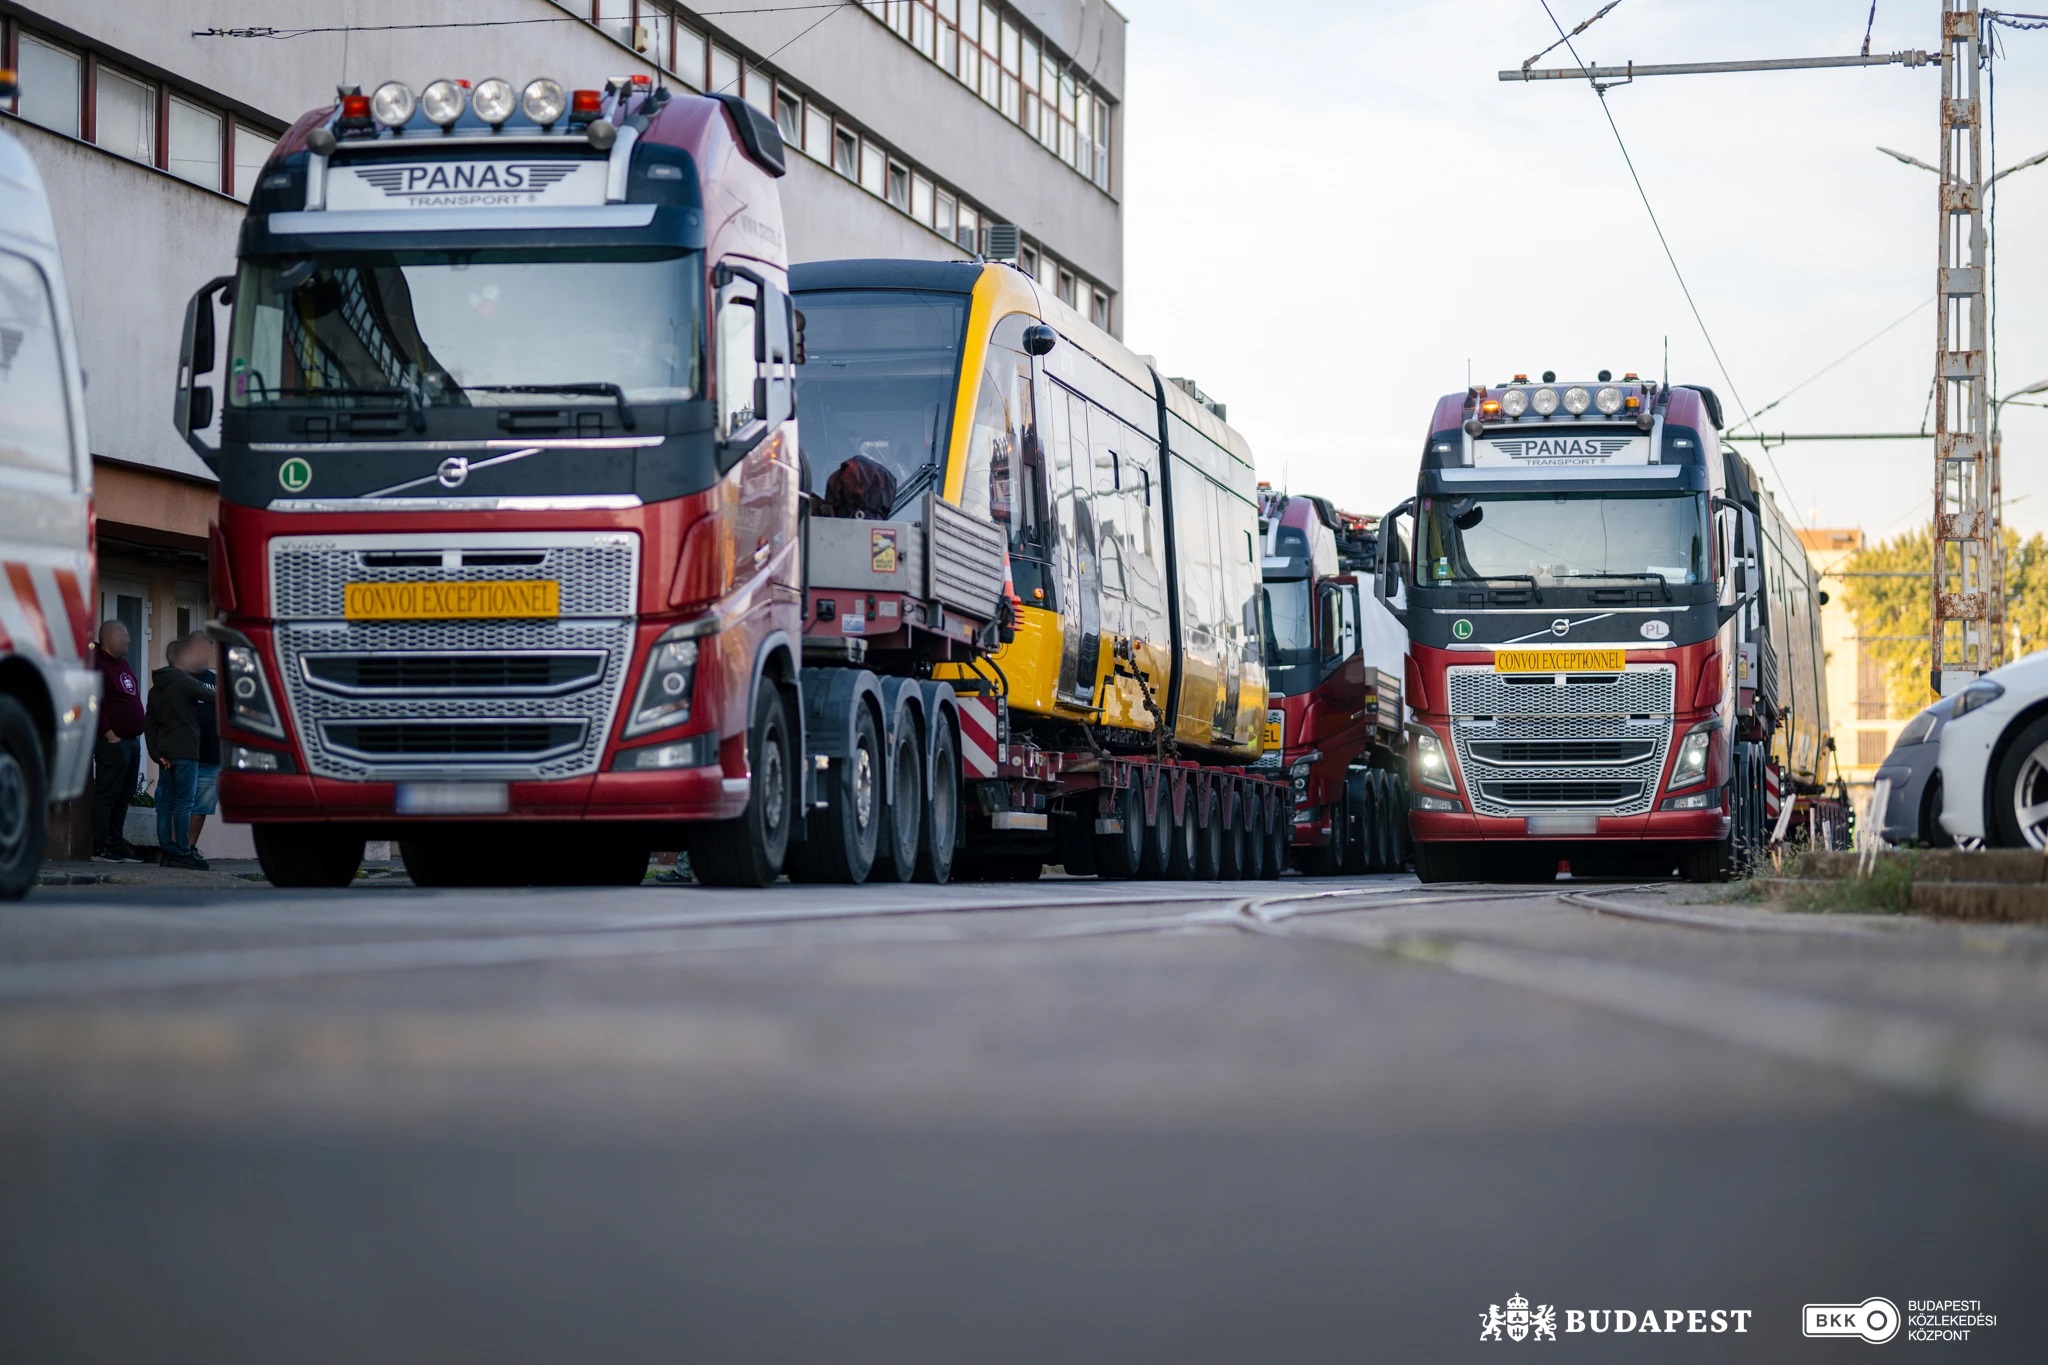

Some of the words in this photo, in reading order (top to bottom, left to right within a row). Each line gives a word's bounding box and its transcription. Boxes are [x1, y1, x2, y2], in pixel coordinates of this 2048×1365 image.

[407, 163, 525, 189] PANAS
[407, 194, 520, 207] TRANSPORT
[1525, 439, 1598, 455] PANAS
[289, 466, 303, 485] L
[350, 586, 418, 615] CONVOI
[422, 584, 551, 614] EXCEPTIONNEL
[1458, 623, 1468, 636] L
[1645, 624, 1664, 636] PL
[1498, 652, 1540, 670] CONVOI
[1542, 651, 1622, 670] EXCEPTIONNEL
